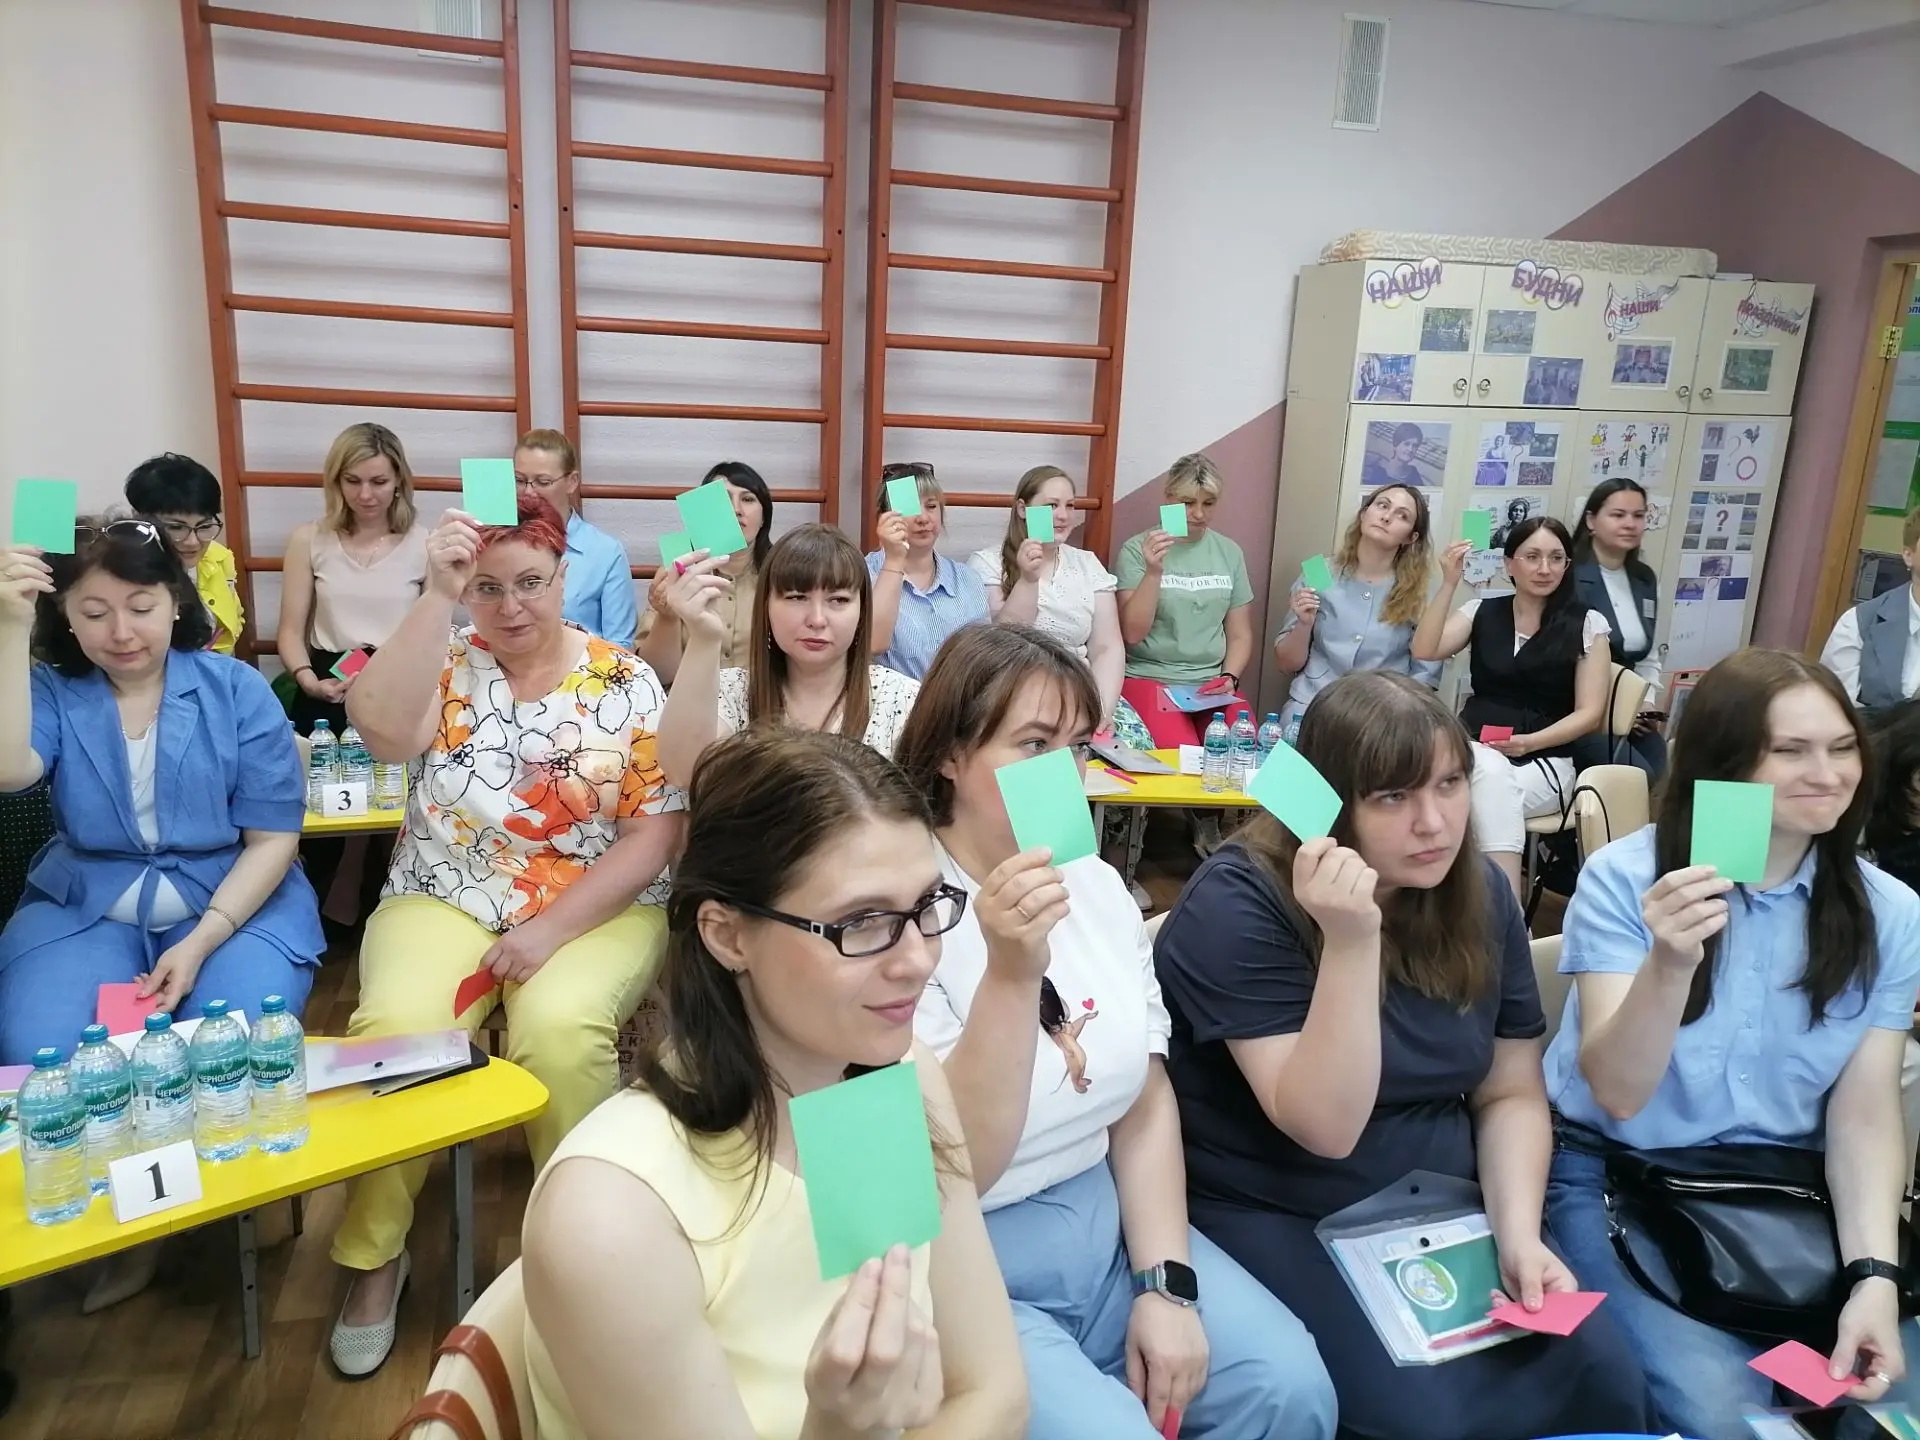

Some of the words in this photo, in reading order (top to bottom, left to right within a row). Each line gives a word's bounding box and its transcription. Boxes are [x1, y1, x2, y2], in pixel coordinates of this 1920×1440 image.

[1370, 265, 1442, 303] НАШИ
[1511, 268, 1584, 307] БУДНИ
[1619, 299, 1661, 317] НАШИ
[1737, 299, 1801, 336] ПРАЗДНИКИ
[337, 790, 352, 811] 3
[144, 1161, 172, 1203] 1
